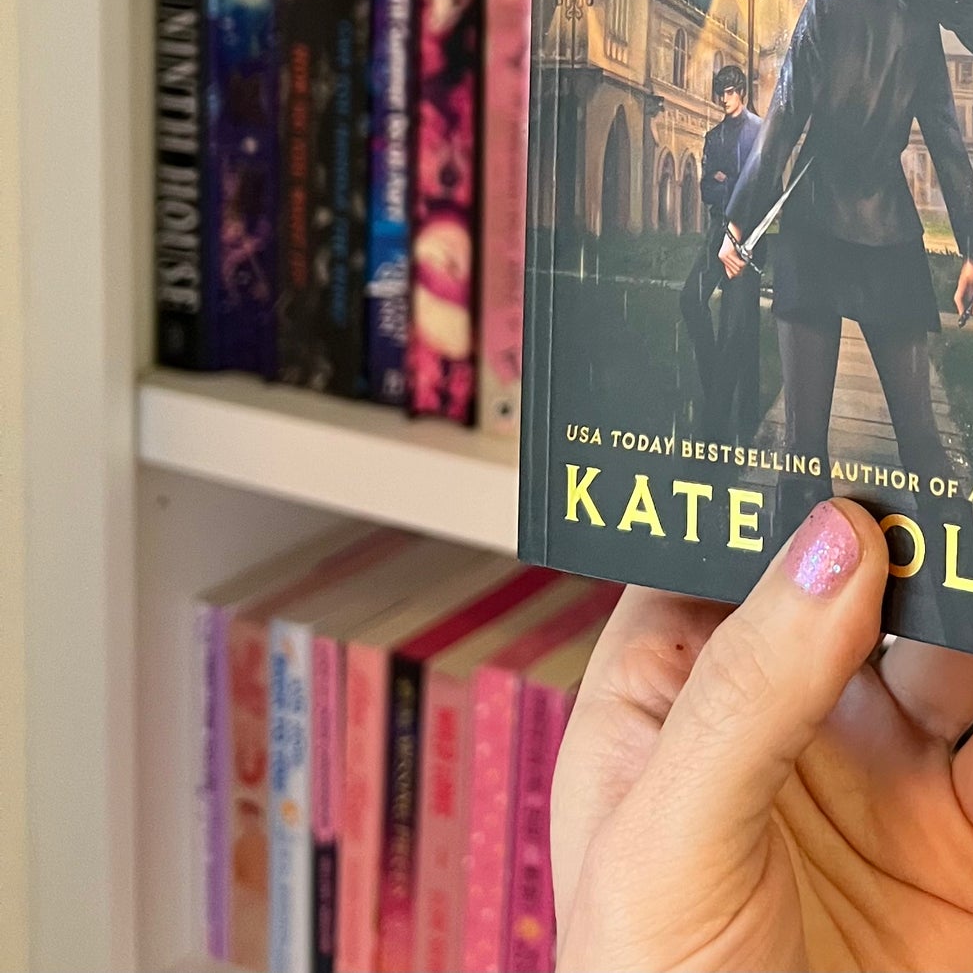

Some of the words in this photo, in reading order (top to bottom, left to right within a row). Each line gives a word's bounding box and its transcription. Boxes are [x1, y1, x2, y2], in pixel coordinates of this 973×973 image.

[565, 424, 602, 445] USA
[610, 429, 674, 456] TODAY
[680, 439, 822, 476] BESTSELLING
[830, 460, 920, 493] AUTHOR
[929, 476, 959, 499] OF
[564, 463, 764, 553] KATE
